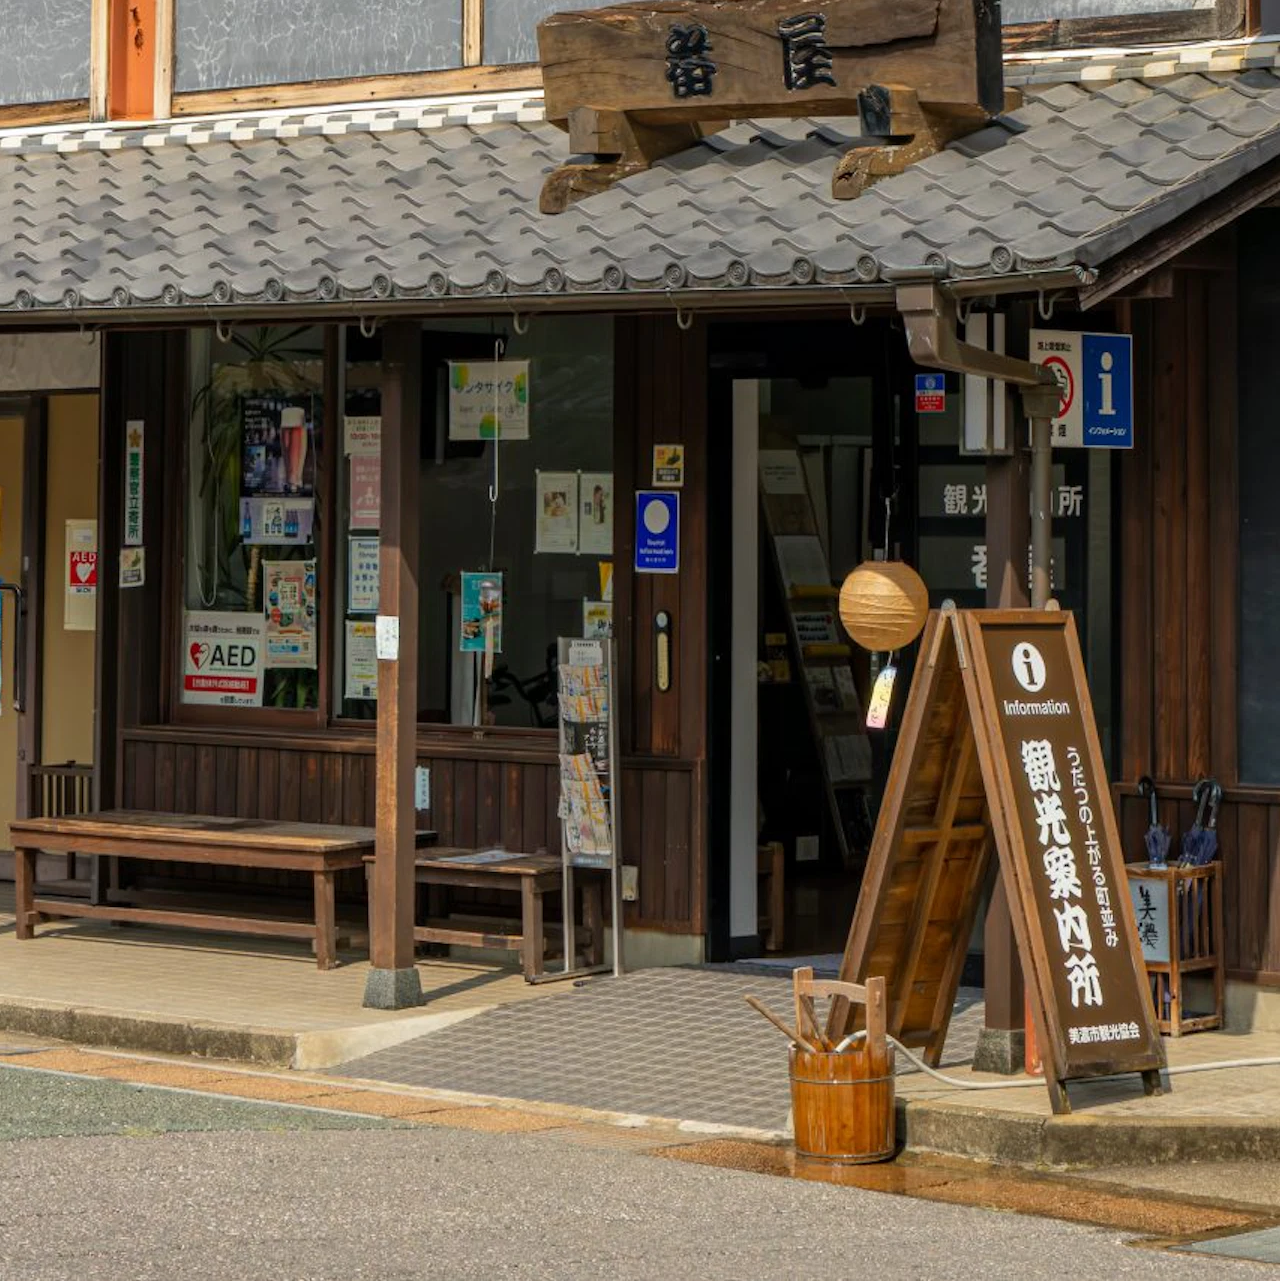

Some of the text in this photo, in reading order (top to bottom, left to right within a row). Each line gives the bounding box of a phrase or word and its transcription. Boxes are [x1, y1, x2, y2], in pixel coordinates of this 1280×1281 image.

[944, 484, 1083, 517] 観光所
[72, 552, 97, 562] AED
[210, 645, 256, 667] AED
[1004, 700, 1070, 716] Information
[1066, 746, 1119, 948] うだつの上がる町並み
[1021, 738, 1104, 1008] 観光案内所
[1068, 1022, 1141, 1045] 美濃市観光協会
